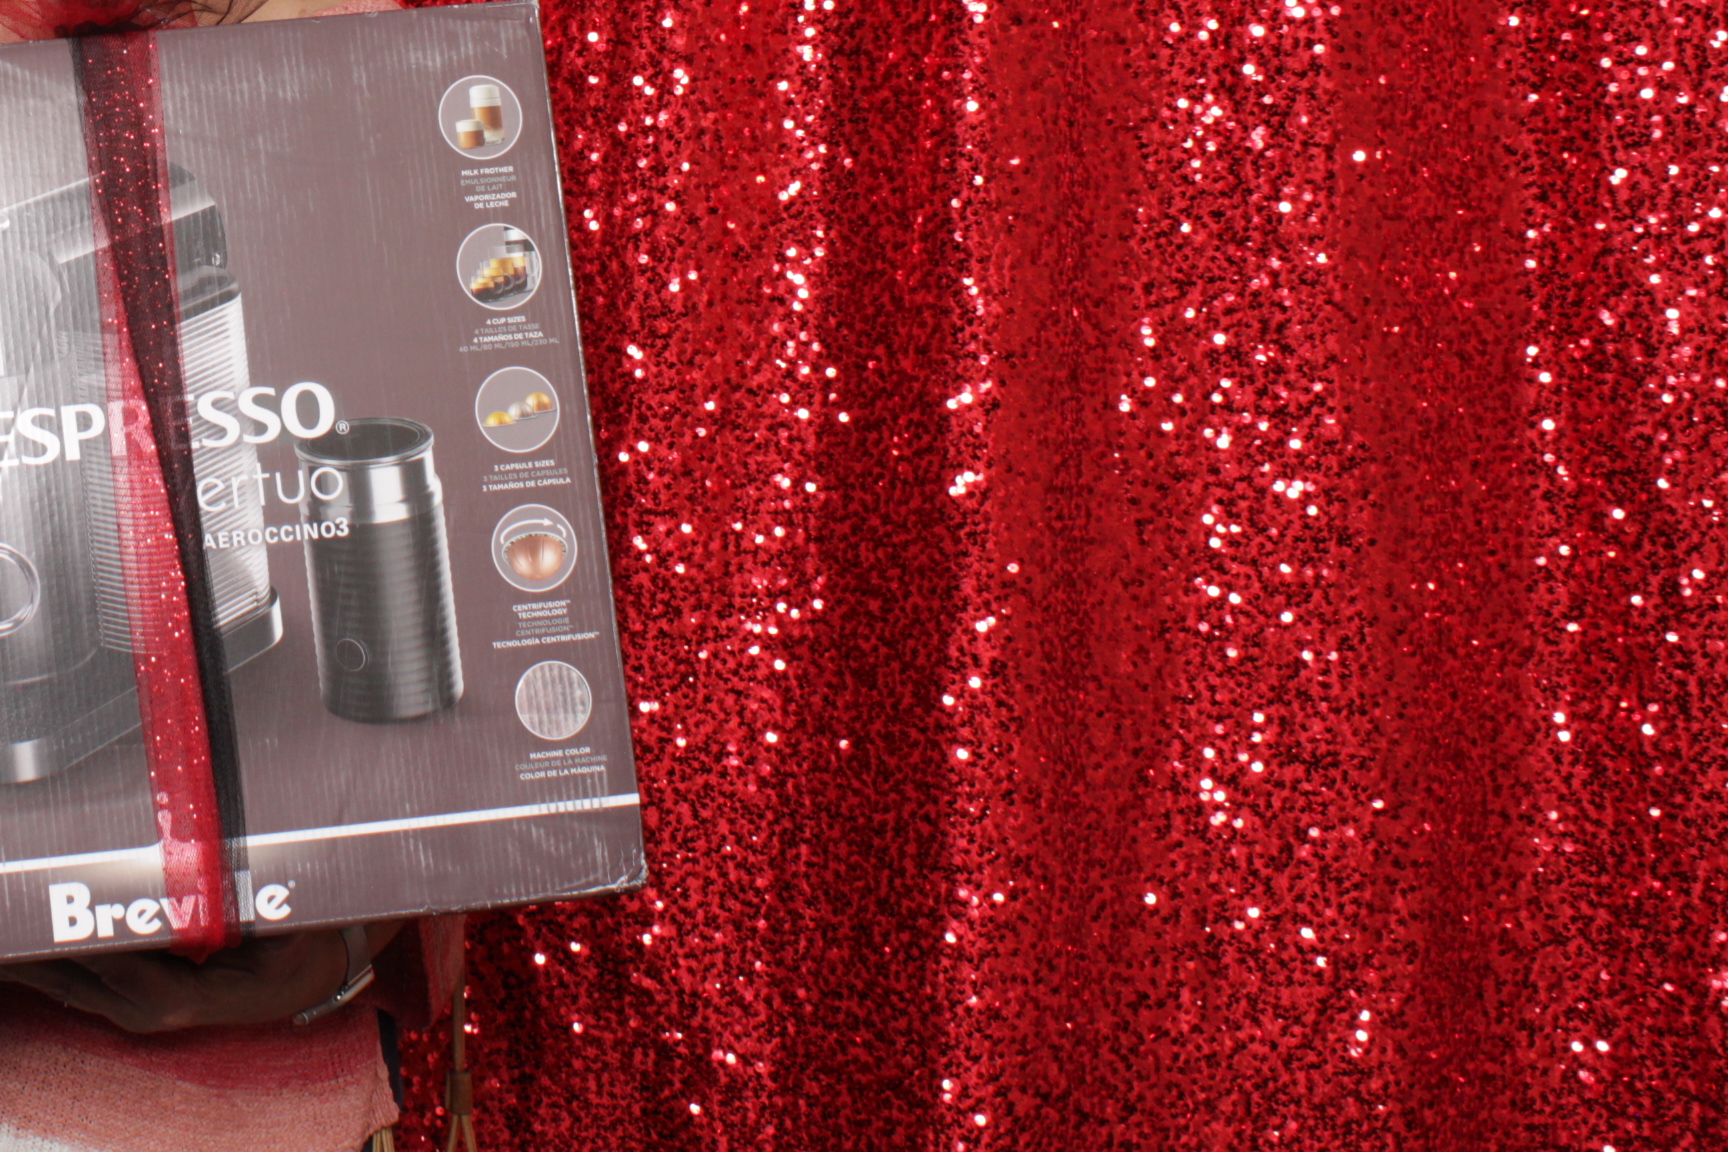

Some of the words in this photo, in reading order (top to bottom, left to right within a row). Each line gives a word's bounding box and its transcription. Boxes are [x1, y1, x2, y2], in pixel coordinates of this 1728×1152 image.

[480, 166, 513, 174] FROTHER
[461, 175, 516, 185] EMULSIONNEUR
[465, 192, 517, 202] VAPORIZADOR
[486, 200, 509, 208] LECHE
[480, 326, 507, 334] TAILLES
[479, 334, 512, 342] TAMAÑOS
[500, 462, 533, 471] CAPSULE
[489, 472, 517, 481] TAILLES
[531, 468, 568, 477] CAPSULES
[196, 462, 344, 512] ertuo
[489, 481, 524, 491] TAMAÑOS
[537, 477, 571, 486] CÁPSULA
[204, 516, 350, 550] AEROCCINO3
[518, 608, 567, 619] TECHNOLOGY
[518, 617, 569, 628] TECHNOLOGIE
[492, 638, 540, 648] TECNOLOGÍA
[530, 750, 563, 759] MACHINE
[565, 747, 590, 755] COLOR
[515, 760, 550, 770] COULEUR
[575, 755, 607, 764] MACHINE
[520, 771, 546, 780] COLOR
[559, 768, 569, 776] LA
[571, 764, 605, 775] MÁQUINA
